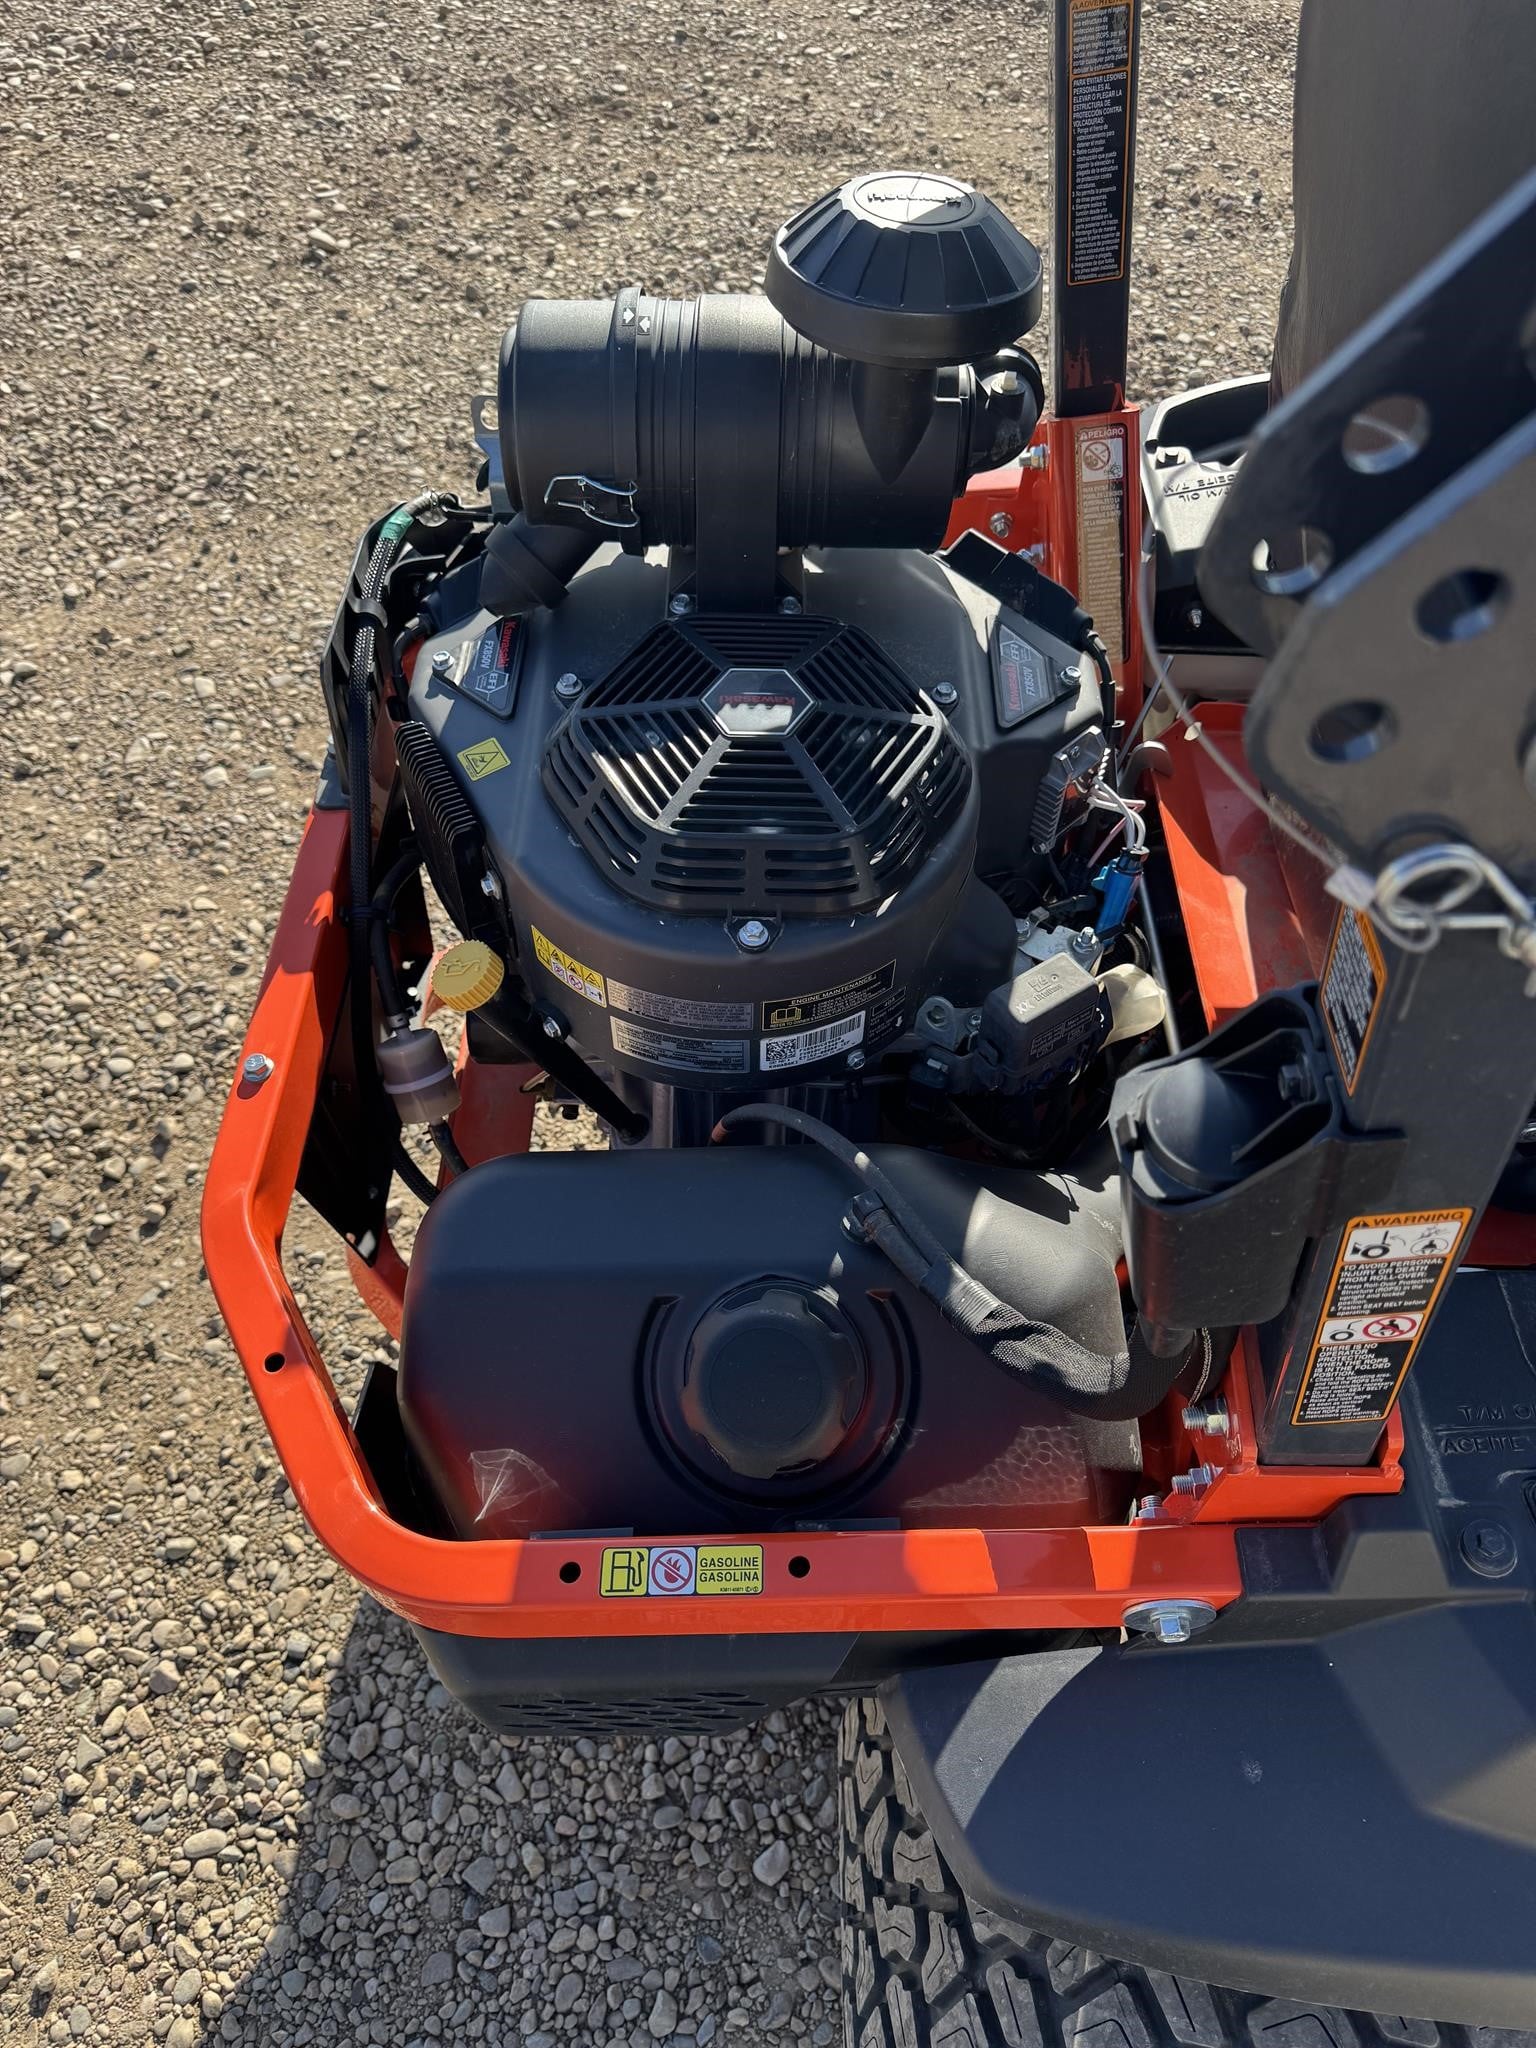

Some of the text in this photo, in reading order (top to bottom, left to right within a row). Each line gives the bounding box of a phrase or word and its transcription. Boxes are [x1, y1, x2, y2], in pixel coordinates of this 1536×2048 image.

[1088, 428, 1124, 438] PELIGRO
[1178, 493, 1200, 502] OIL
[497, 620, 516, 669] Kawasaki
[791, 995, 820, 1005] ENGINE
[822, 976, 873, 998] MAINTENANCE
[1373, 1211, 1464, 1227] WARNING
[1390, 1258, 1443, 1267] PERSONAL
[1341, 1269, 1376, 1277] INJURY
[1339, 1275, 1368, 1284] FROM
[1318, 1354, 1375, 1362] PROTECTION
[1443, 1436, 1525, 1454] ACEITE
[700, 1557, 759, 1568] GASOLINE
[700, 1572, 759, 1582] GASOLINA
